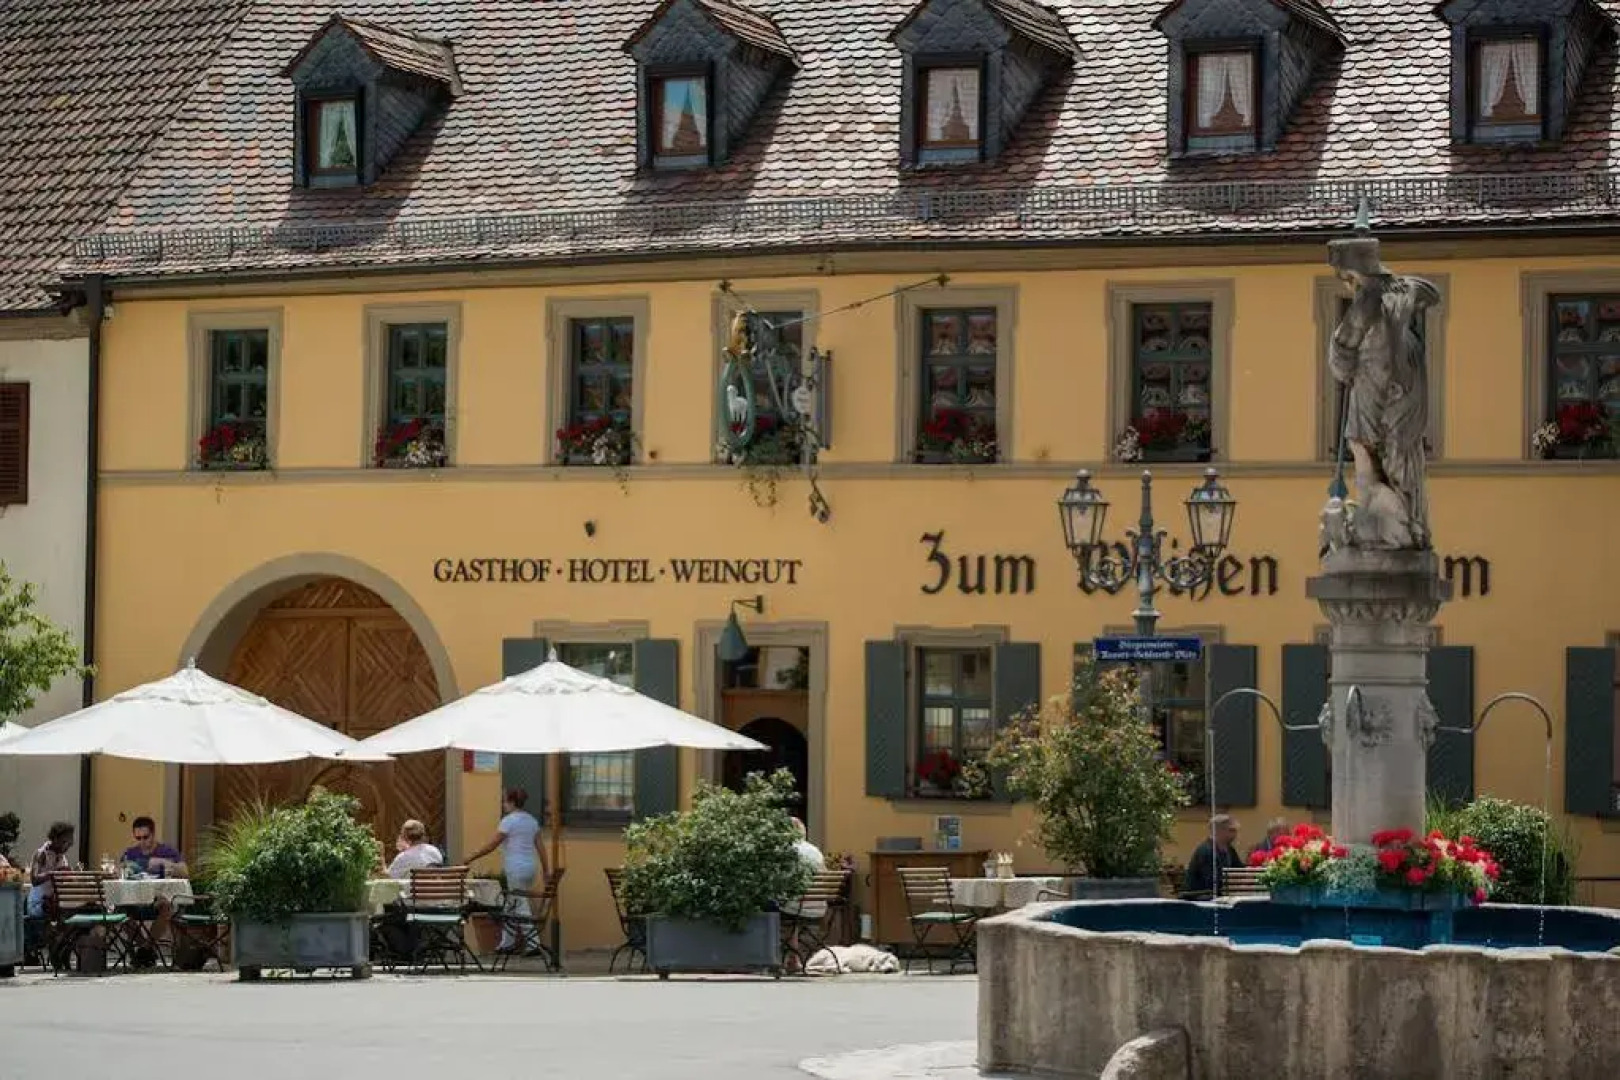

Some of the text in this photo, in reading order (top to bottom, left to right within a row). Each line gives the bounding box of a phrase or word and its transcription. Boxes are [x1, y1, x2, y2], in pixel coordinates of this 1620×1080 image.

[433, 558, 802, 584] GASTHOF HOTEL WEINGUT
[920, 531, 1036, 595] Zum
